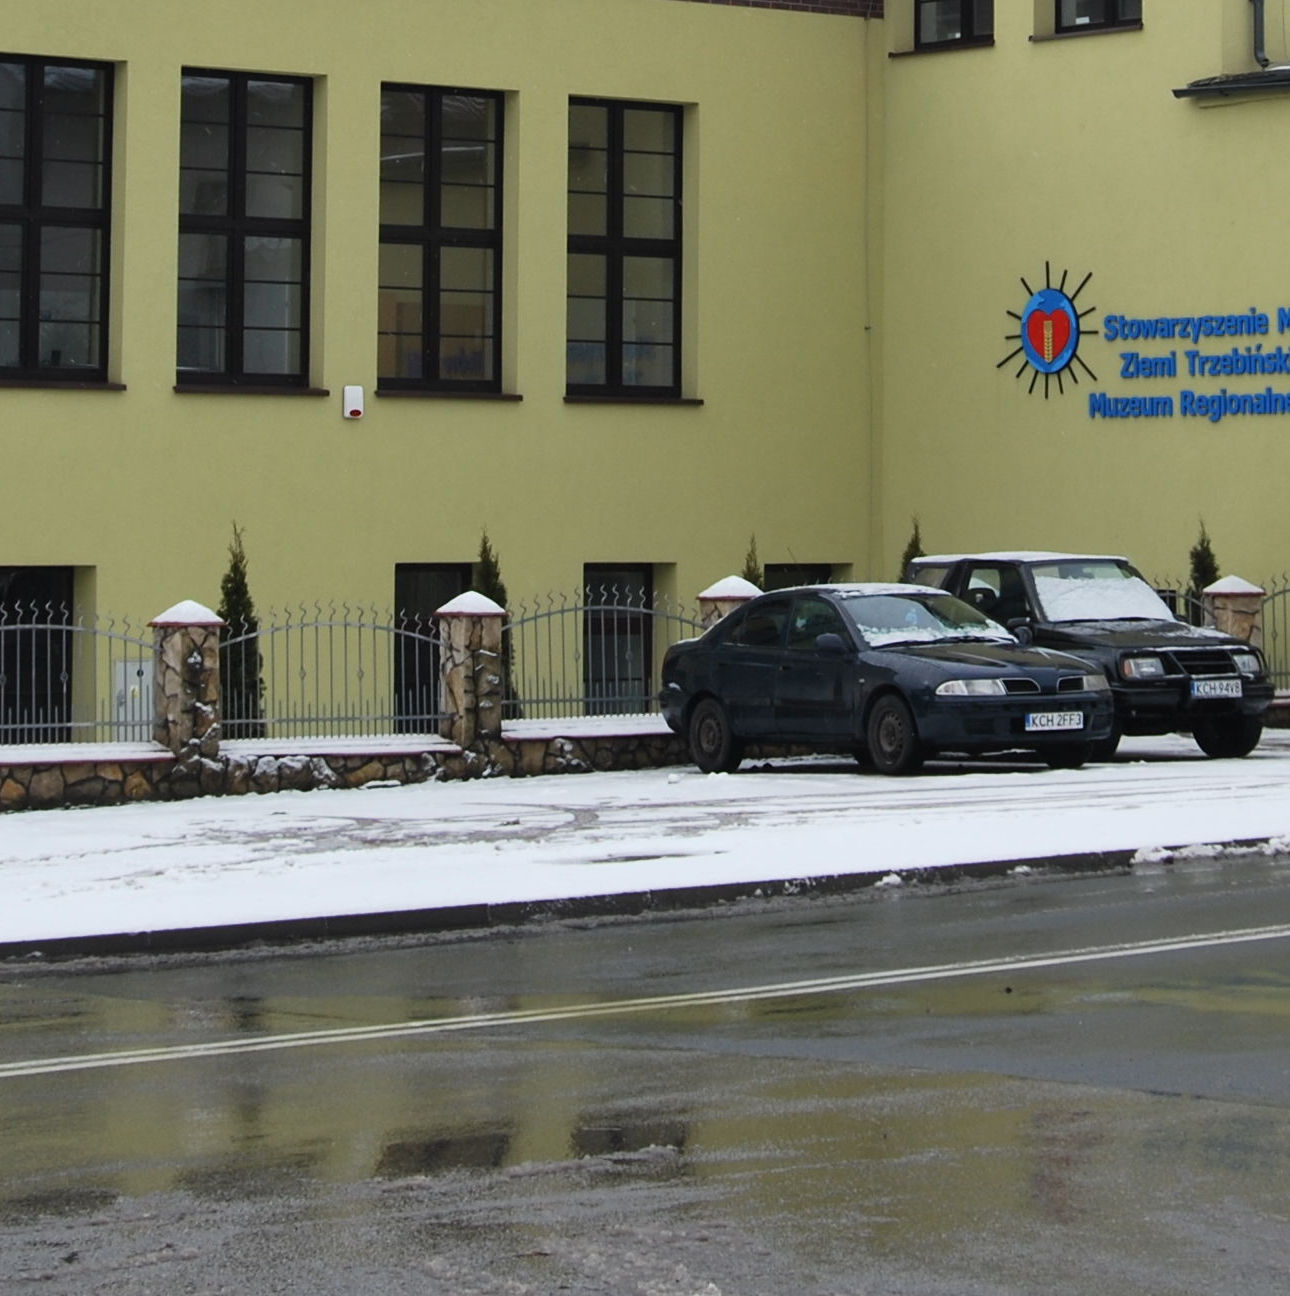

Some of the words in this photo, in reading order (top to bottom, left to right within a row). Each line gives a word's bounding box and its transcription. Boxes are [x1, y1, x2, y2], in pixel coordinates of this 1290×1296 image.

[1104, 307, 1269, 344] Stowarzyszenie
[1119, 351, 1177, 379] Ziemi
[1089, 392, 1174, 418] Muzeum
[1196, 682, 1216, 695] KCH
[1032, 715, 1054, 727] KCH
[1057, 714, 1082, 726] 2FF3
